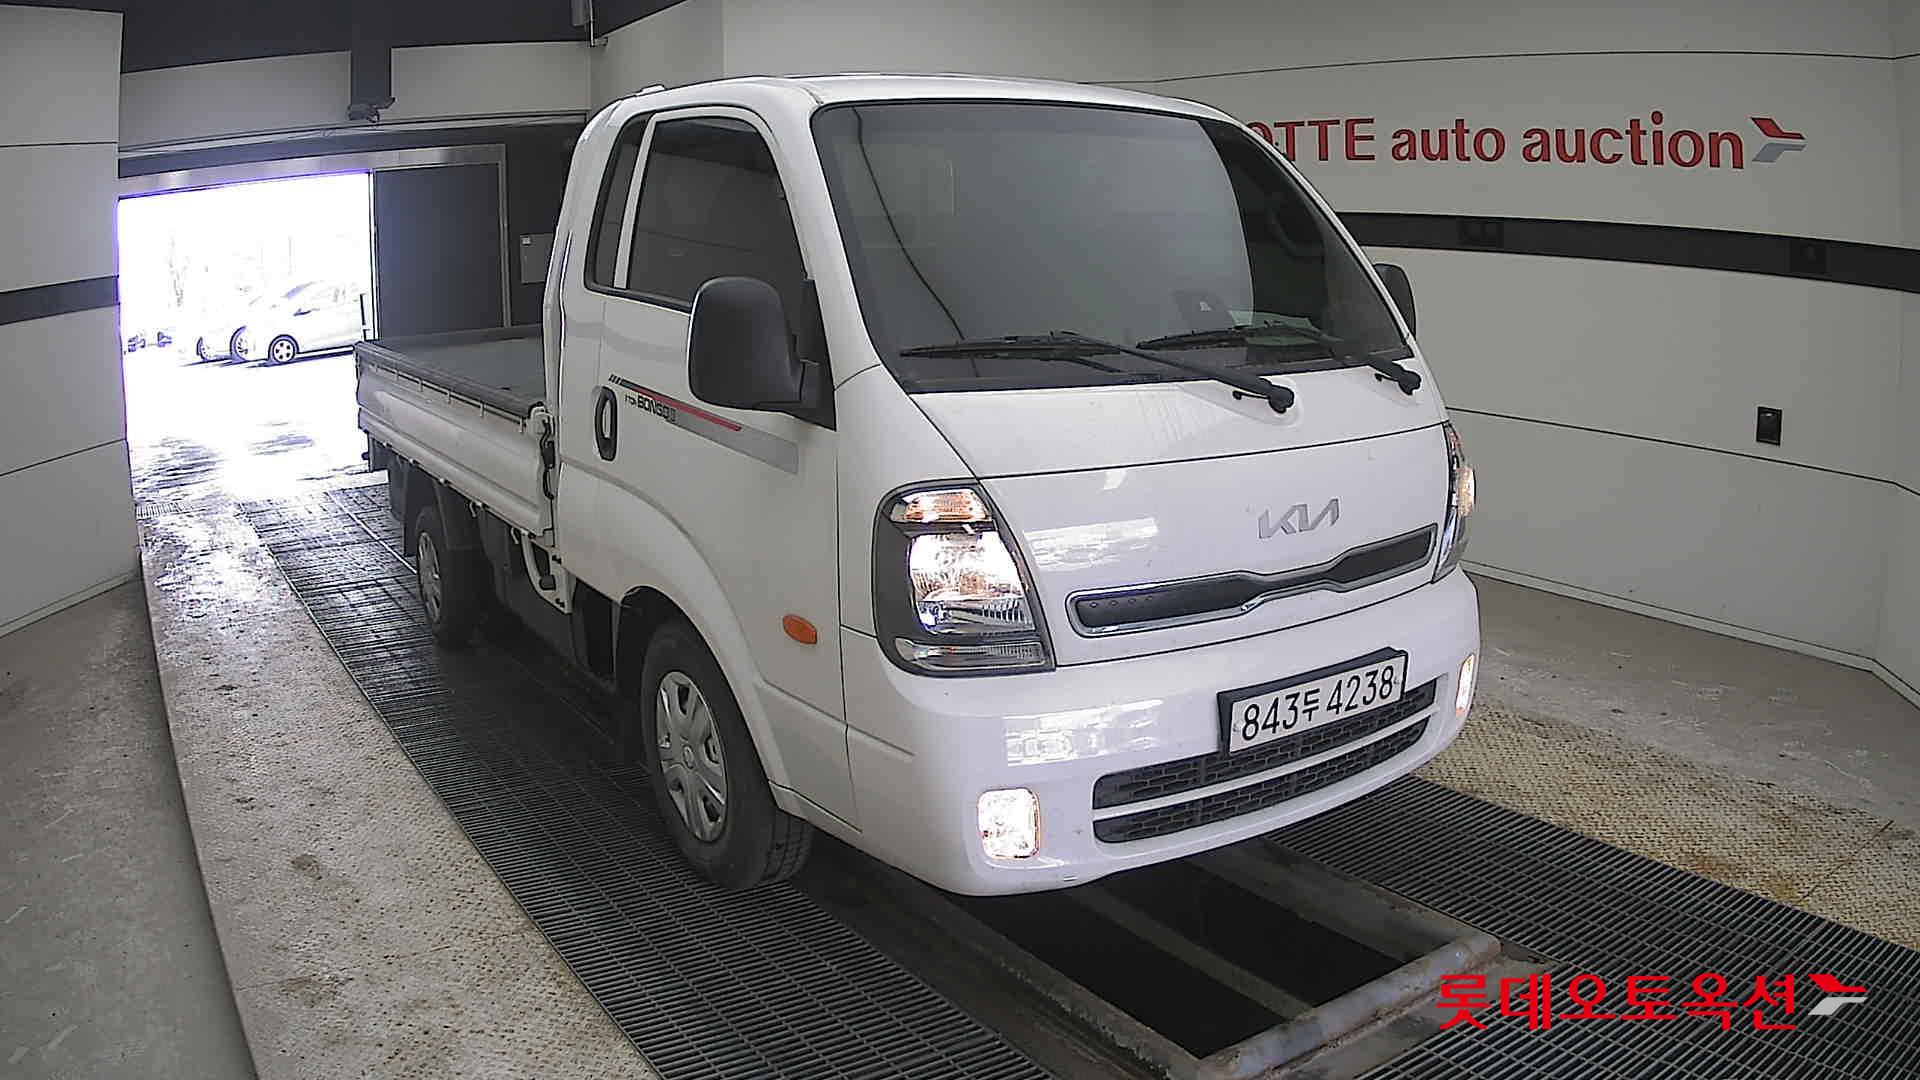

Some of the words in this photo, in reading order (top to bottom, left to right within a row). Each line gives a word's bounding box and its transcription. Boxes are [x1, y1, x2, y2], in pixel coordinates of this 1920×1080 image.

[1391, 119, 1505, 162] auto
[1521, 111, 1744, 169] auction
[1258, 497, 1340, 539] KIA
[1242, 688, 1320, 740] 843두
[1326, 665, 1394, 715] 4238
